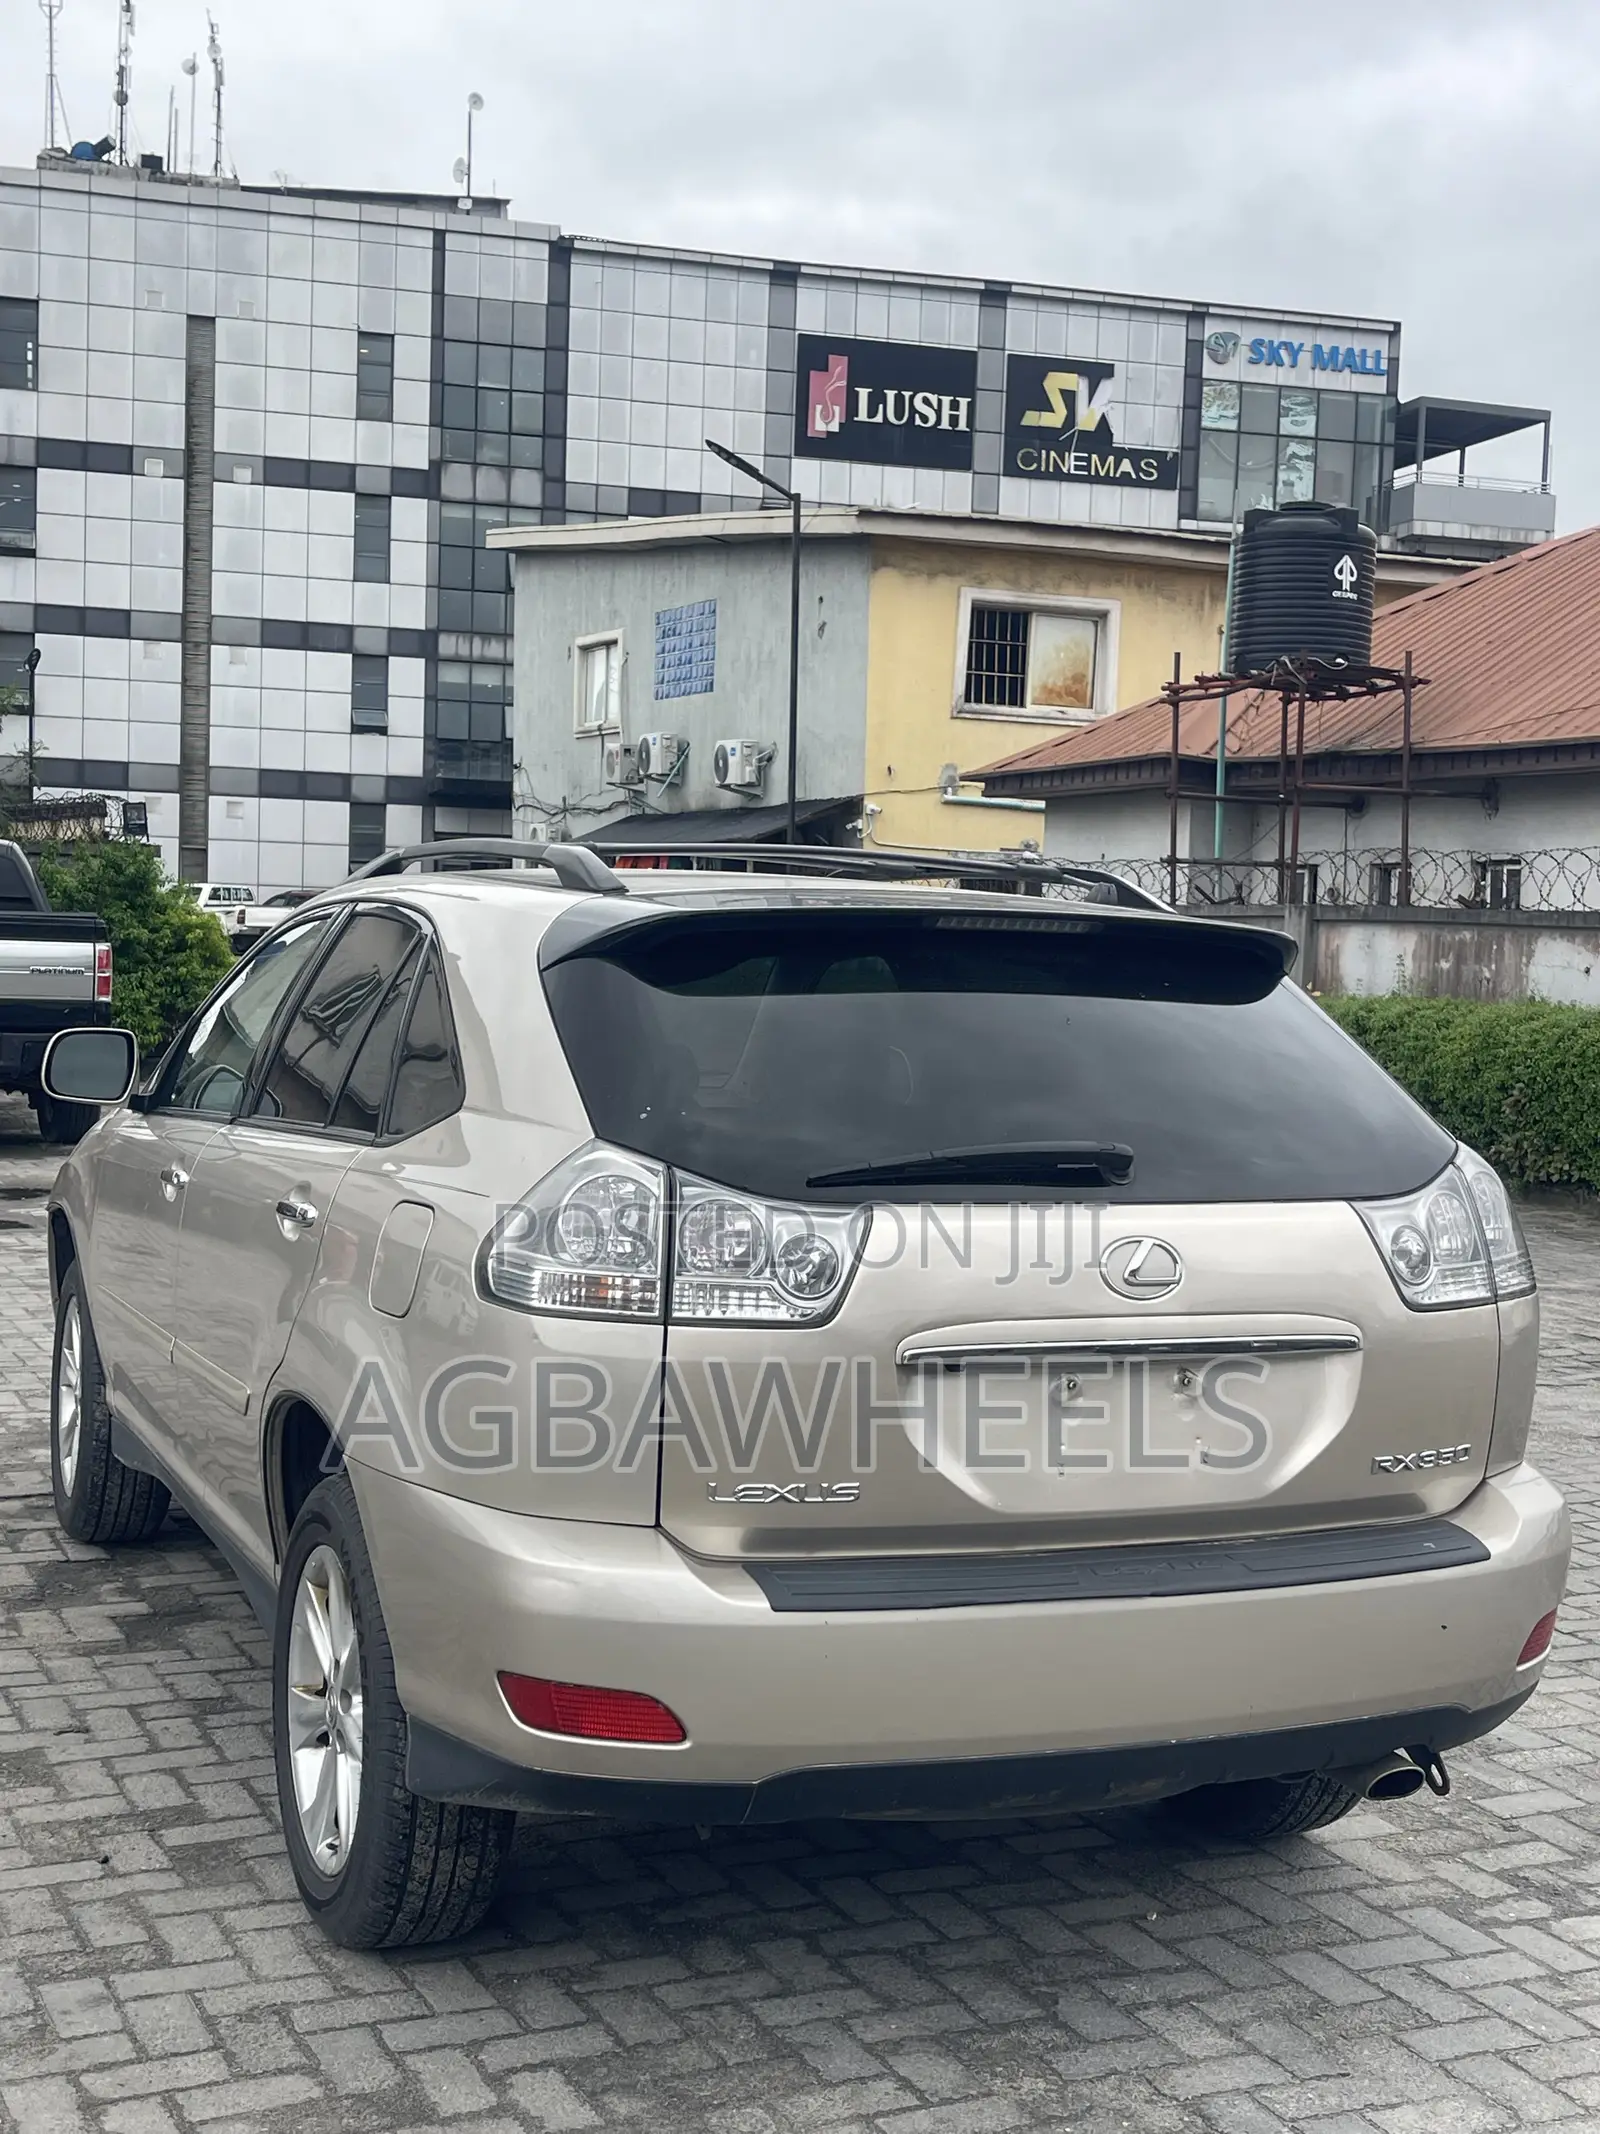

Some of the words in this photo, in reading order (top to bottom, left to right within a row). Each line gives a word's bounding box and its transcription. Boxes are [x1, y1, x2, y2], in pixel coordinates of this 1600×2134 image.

[1248, 337, 1304, 368] SKY
[1311, 343, 1388, 376] MALL
[853, 387, 972, 432] LUSH
[1016, 447, 1159, 481] CINEMAS
[1371, 1444, 1472, 1475] RX350
[707, 1482, 861, 1503] LEXUS
